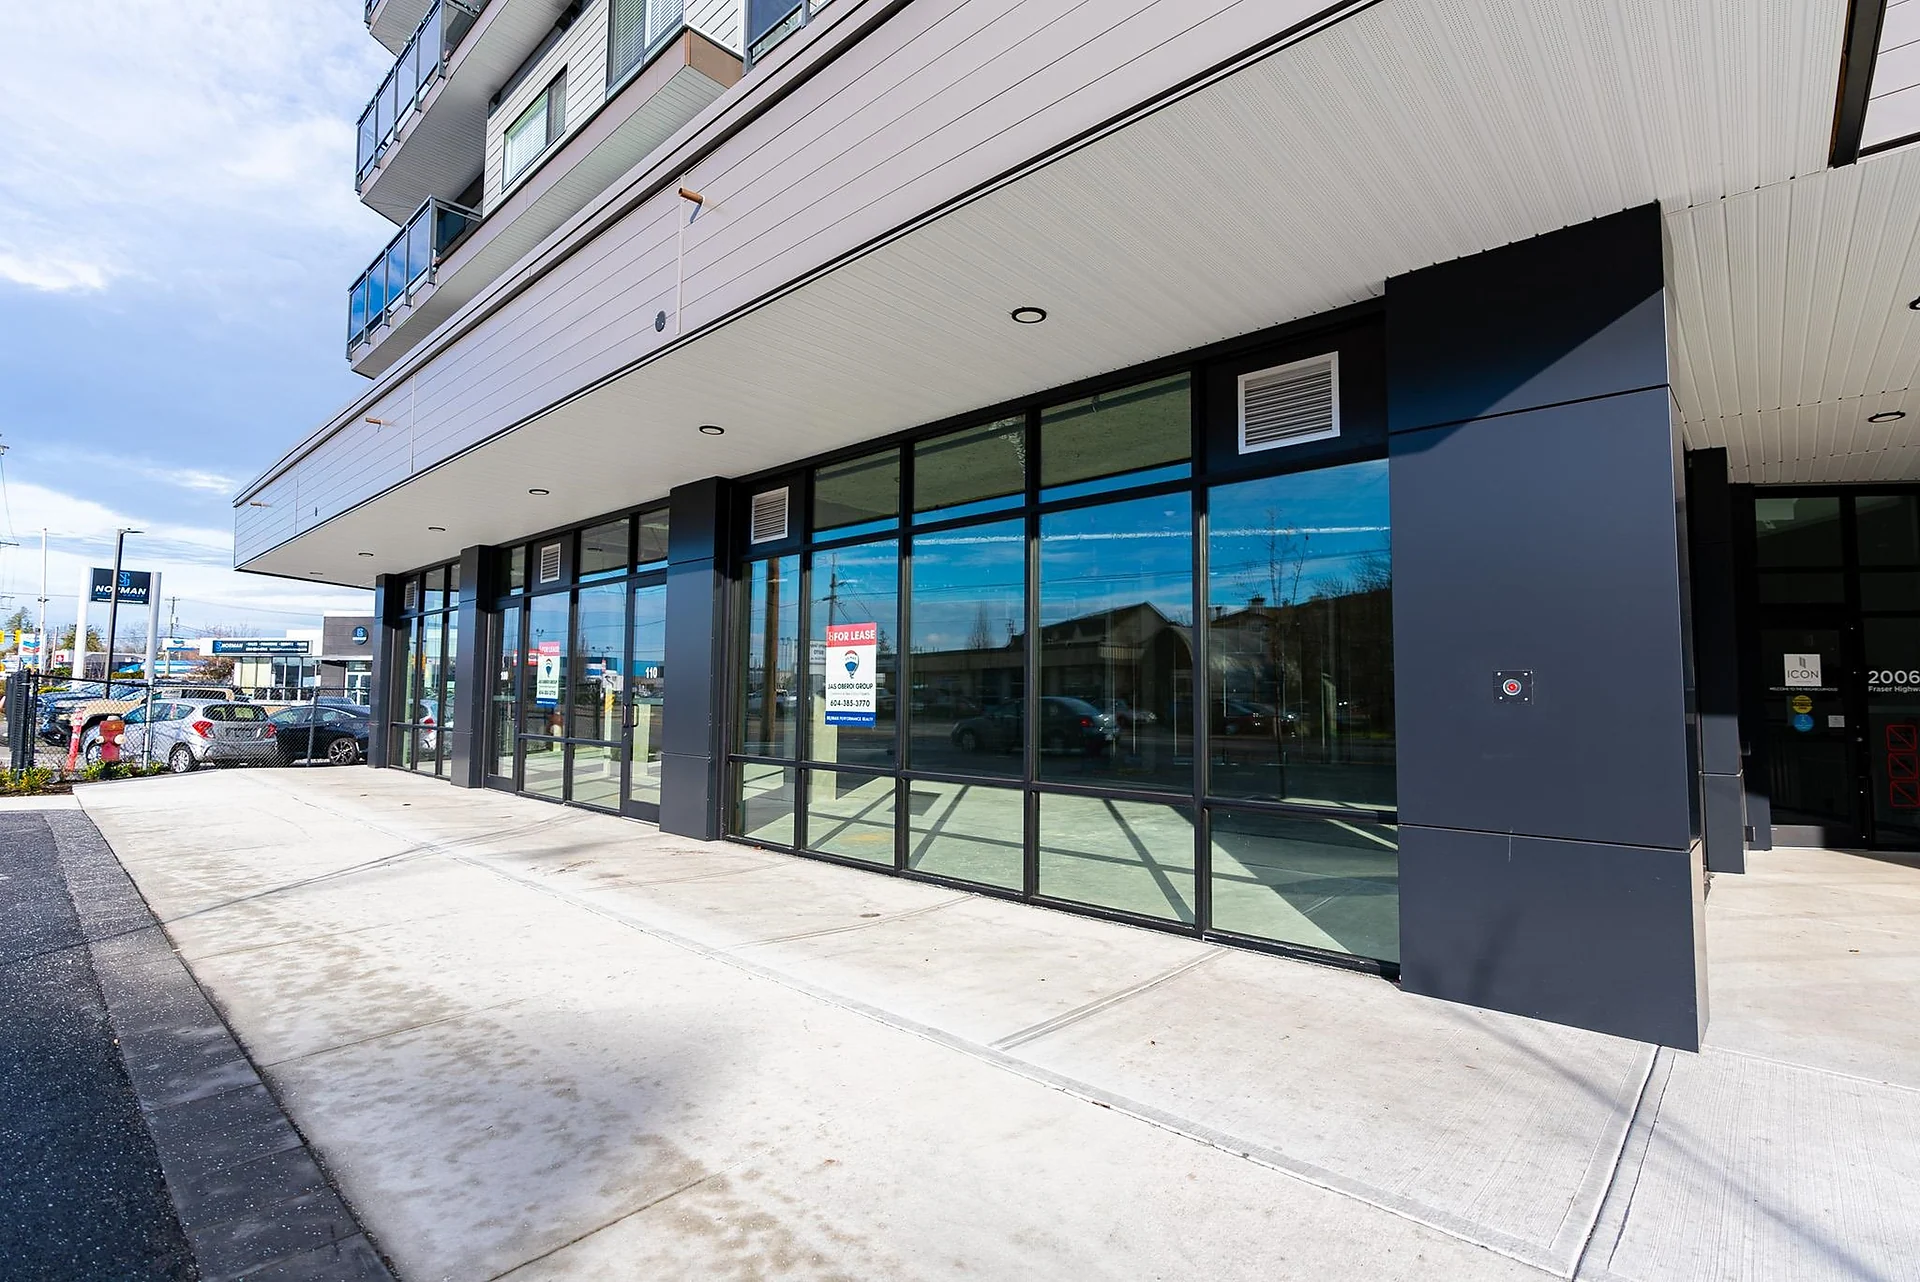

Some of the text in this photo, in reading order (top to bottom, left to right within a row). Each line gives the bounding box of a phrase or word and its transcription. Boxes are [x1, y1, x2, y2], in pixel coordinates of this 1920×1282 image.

[95, 585, 147, 595] NOMAN
[834, 629, 875, 641] FOR LEASE
[645, 666, 659, 679] 110
[1787, 670, 1819, 678] ICON
[1868, 685, 1920, 693] Fraser Highw
